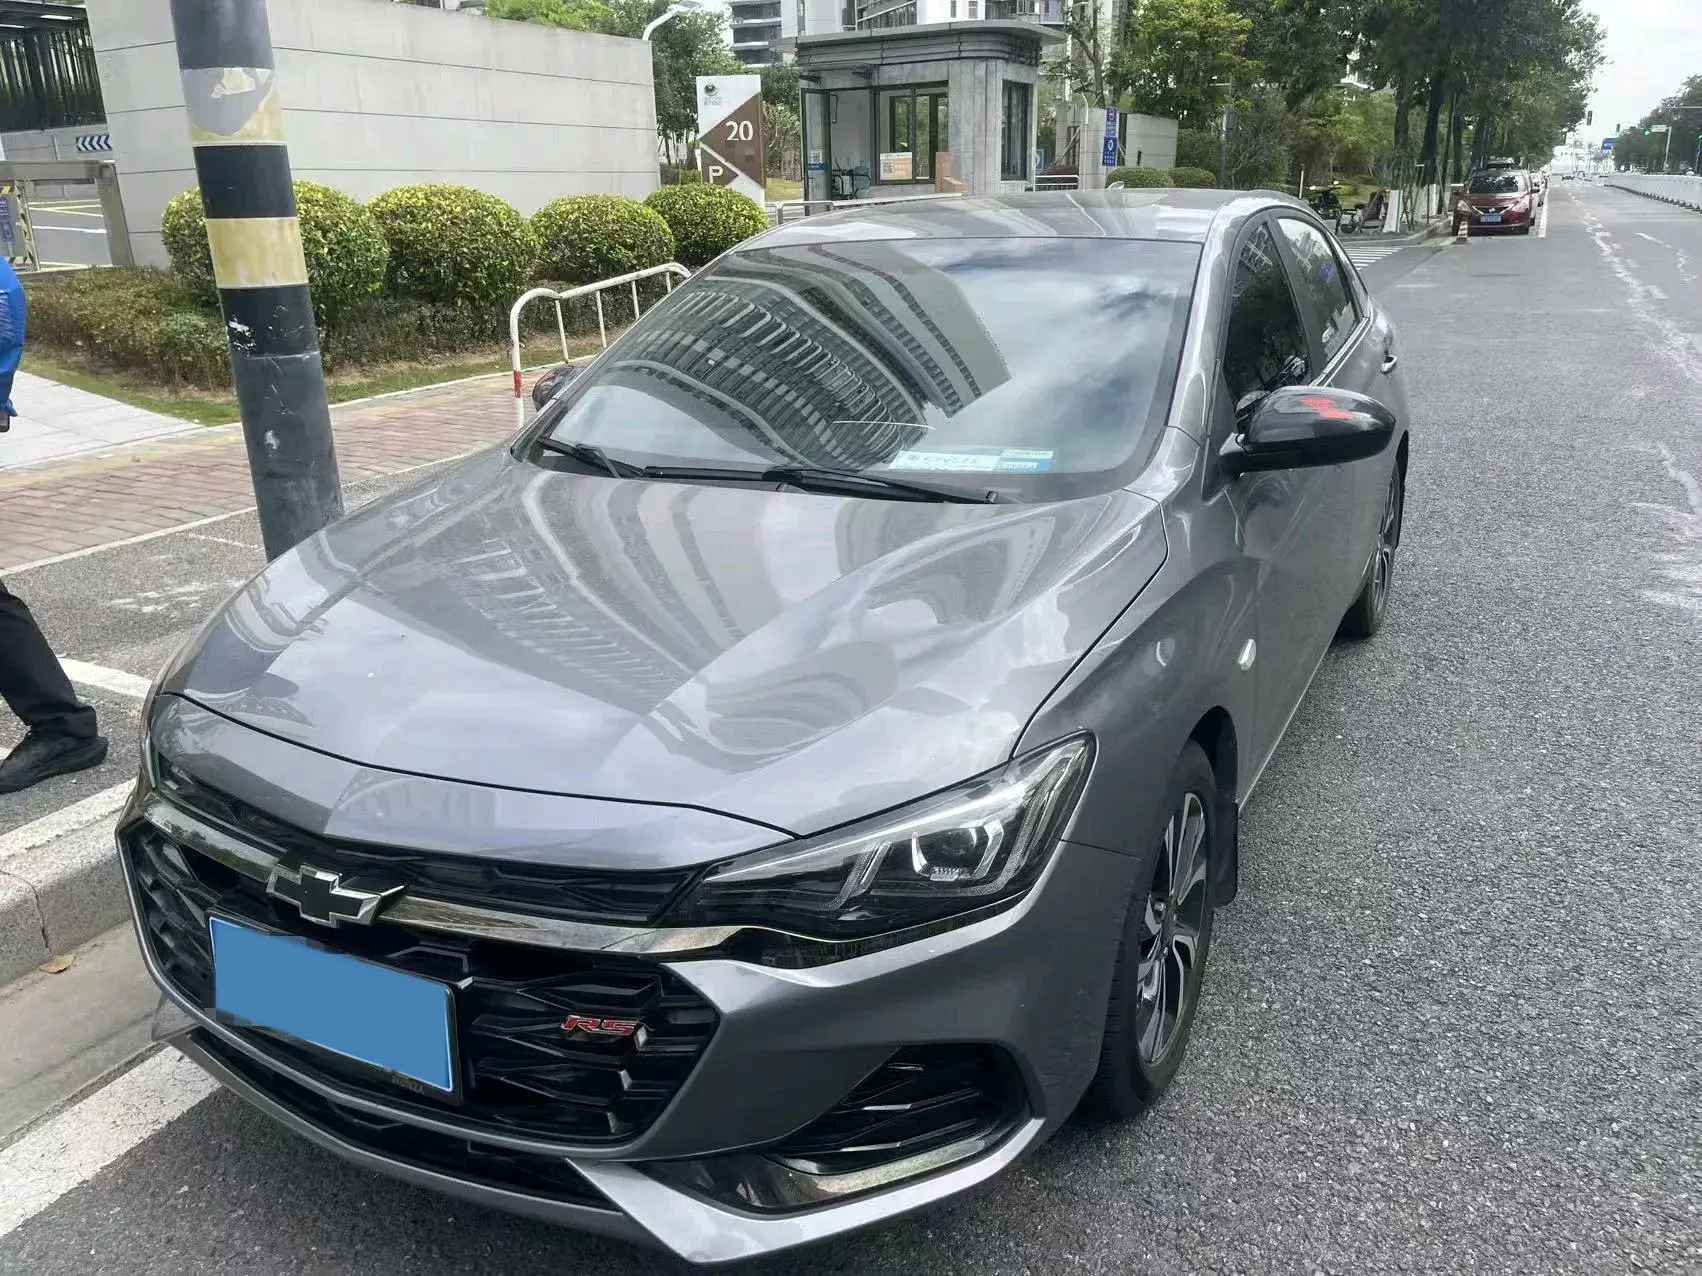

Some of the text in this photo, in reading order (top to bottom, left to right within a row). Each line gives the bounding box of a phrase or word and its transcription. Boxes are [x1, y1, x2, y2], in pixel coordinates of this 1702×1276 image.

[726, 121, 753, 141] 20
[709, 166, 723, 184] P
[561, 1015, 636, 1036] RS
